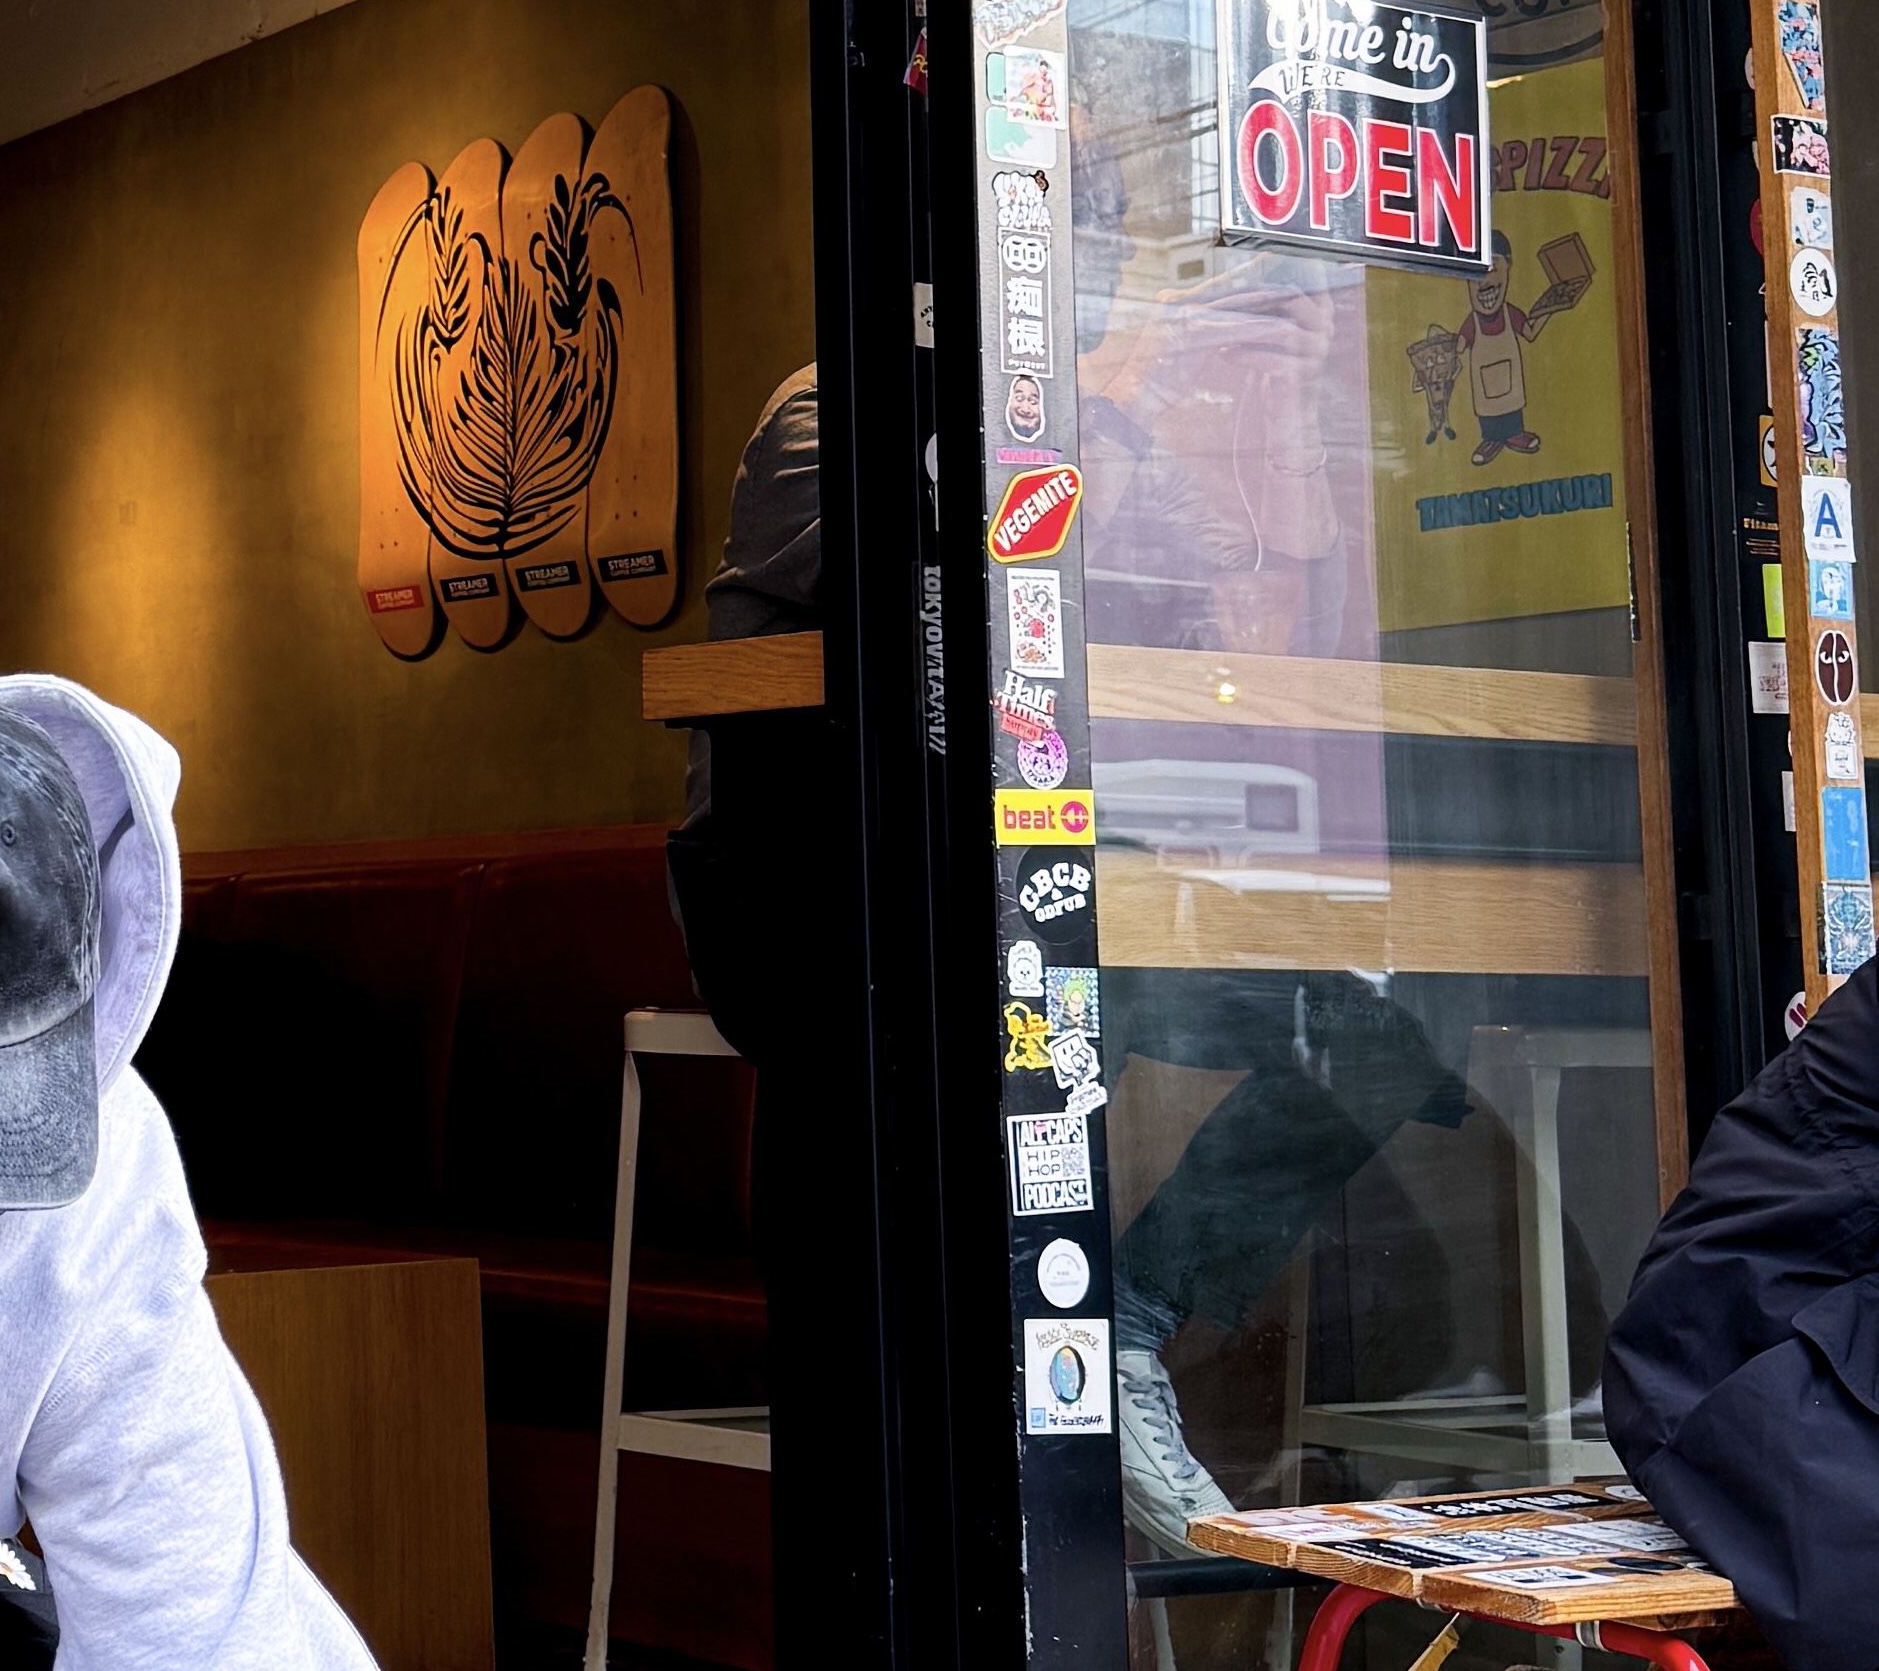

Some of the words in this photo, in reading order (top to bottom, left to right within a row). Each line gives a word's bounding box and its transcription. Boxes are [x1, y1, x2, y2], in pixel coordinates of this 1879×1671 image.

[1394, 12, 1439, 72] in
[1236, 99, 1477, 255] OPEN
[1495, 136, 1611, 199] PIZZ
[993, 471, 1078, 553] VEGEMITE
[1416, 472, 1613, 532] TAMATSUKURI
[1813, 492, 1842, 539] A
[525, 565, 569, 580] STREAMER
[608, 555, 655, 570] STREAMER
[449, 578, 489, 592] STREAMER
[996, 690, 1055, 732] Times
[1004, 670, 1056, 712] Half
[1003, 804, 1057, 830] beat
[1027, 1148, 1060, 1162] HIP
[1028, 1162, 1061, 1176] HOP
[1023, 1179, 1089, 1211] PODCAST
